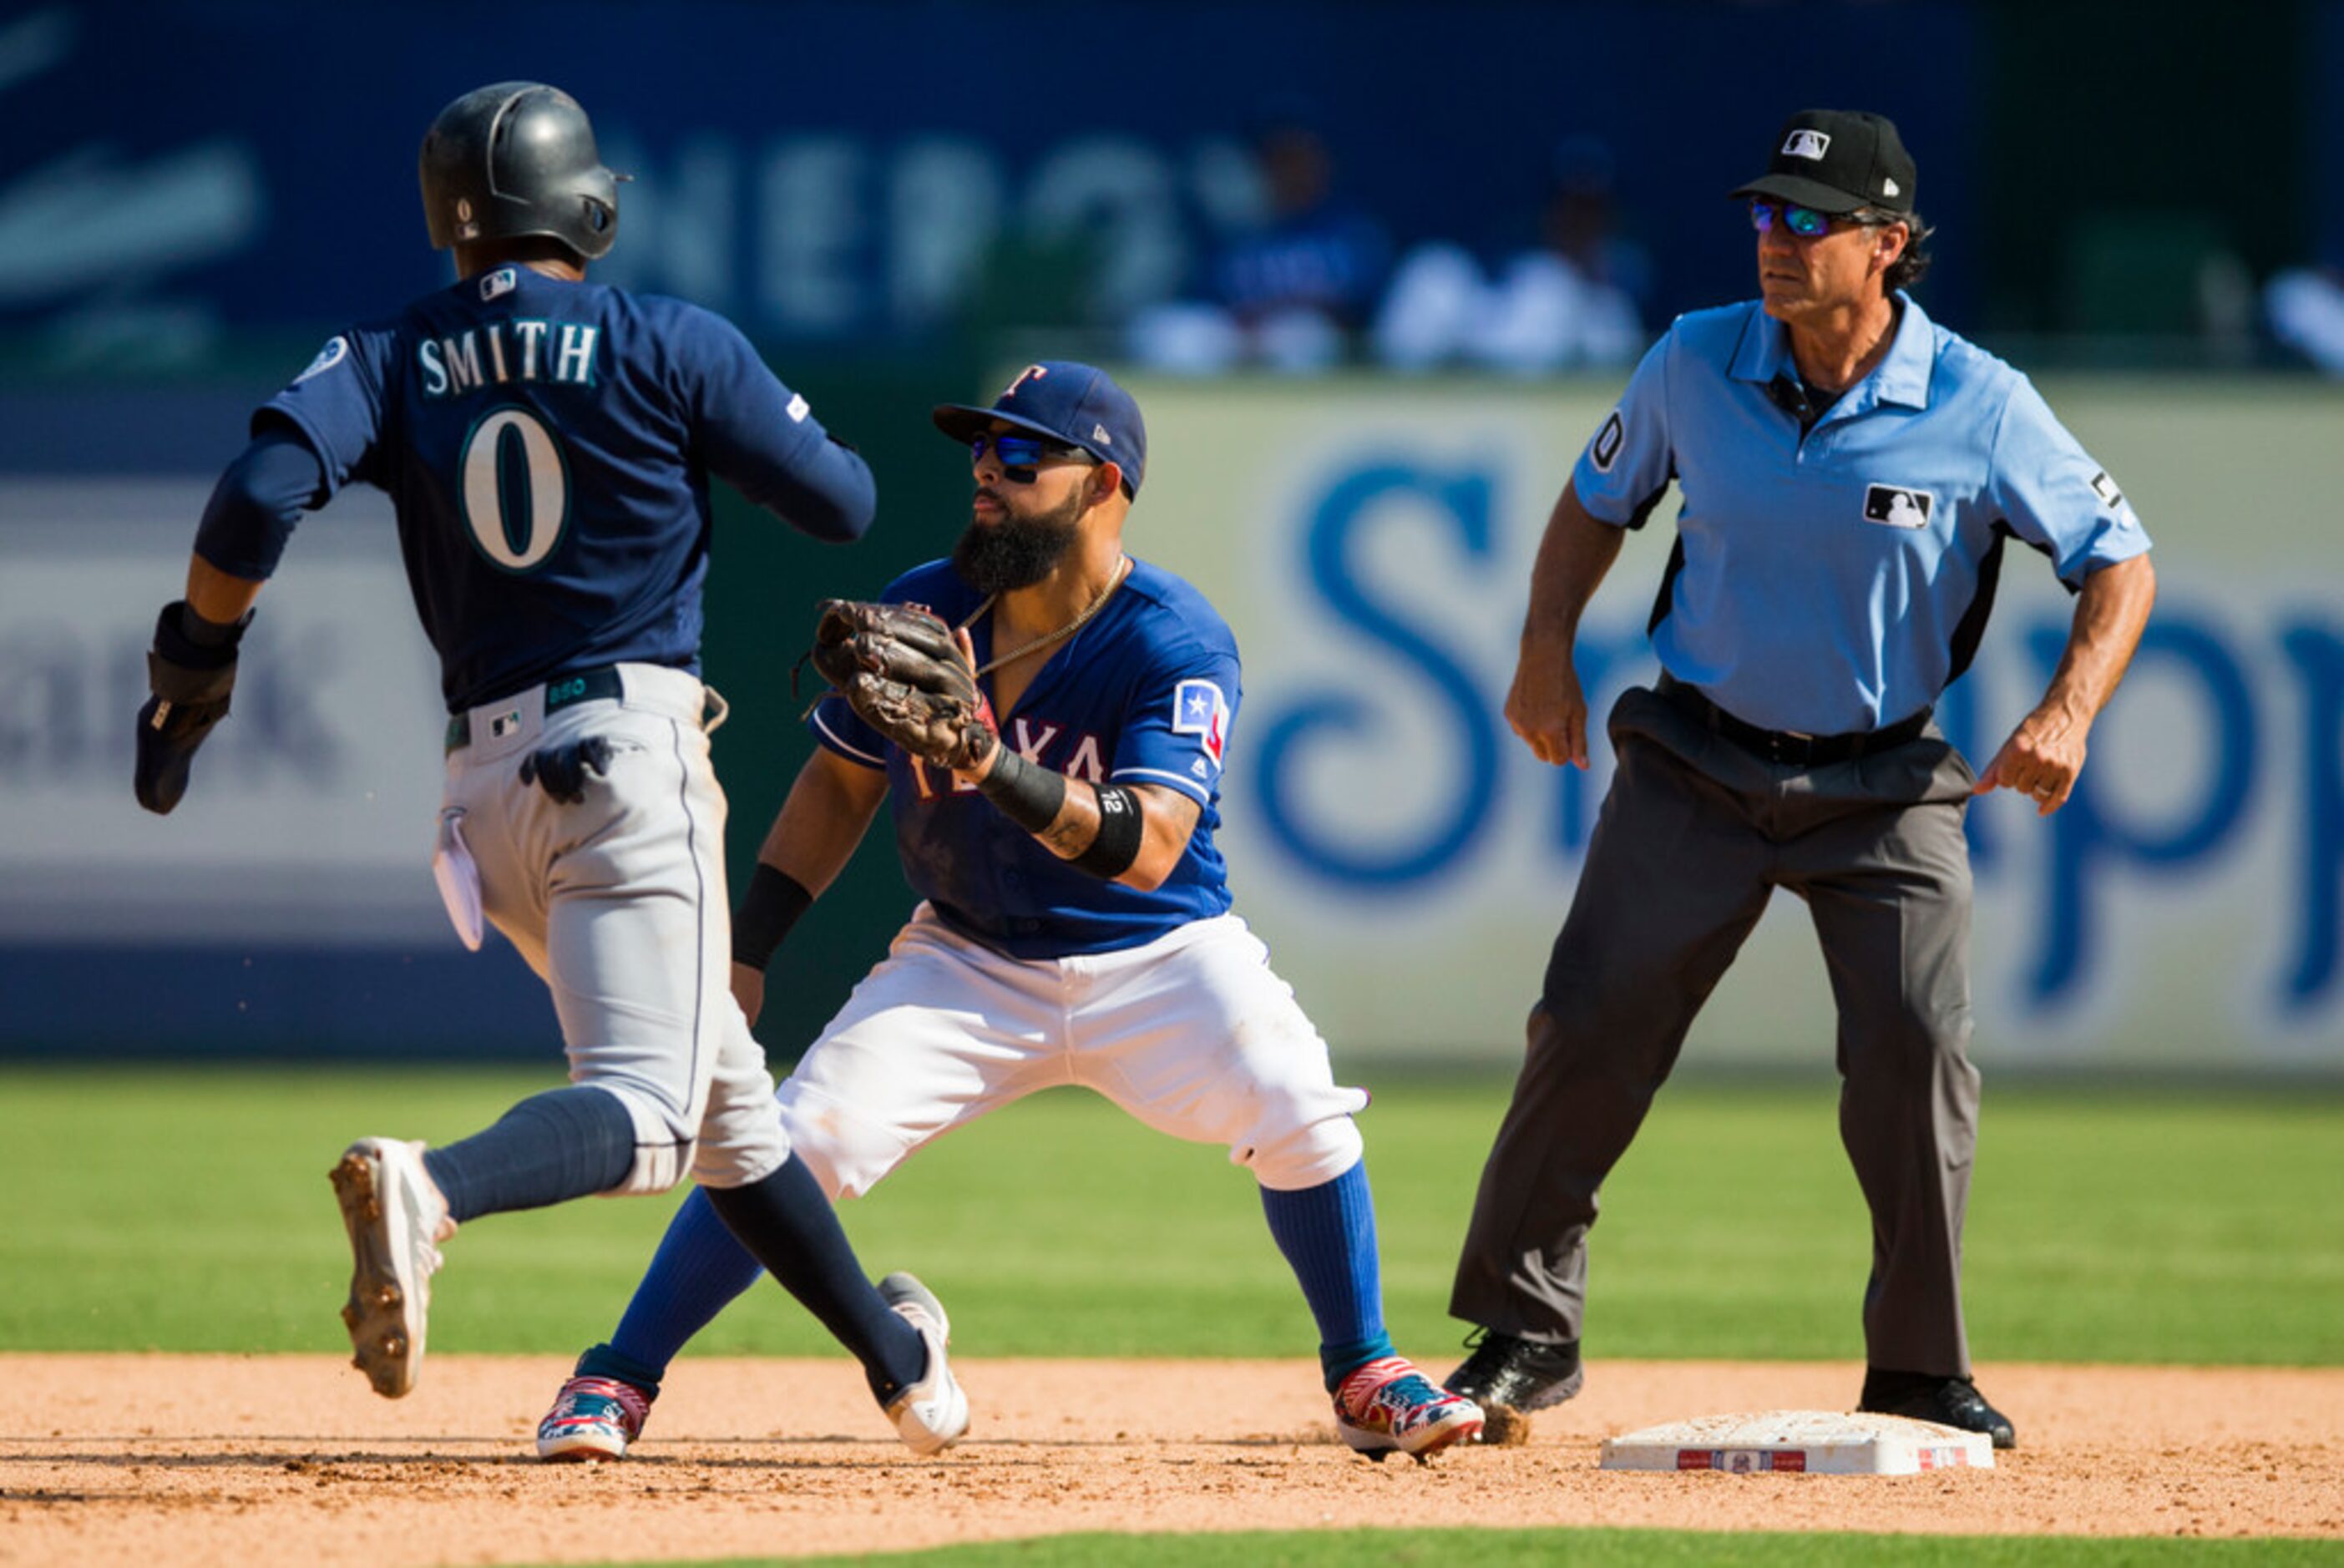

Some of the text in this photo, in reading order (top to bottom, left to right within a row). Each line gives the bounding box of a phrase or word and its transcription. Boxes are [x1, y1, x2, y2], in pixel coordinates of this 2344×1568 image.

[457, 197, 472, 222] 0
[418, 318, 600, 397] SMITH
[457, 402, 572, 576] 0
[1101, 788, 1124, 813] 12
